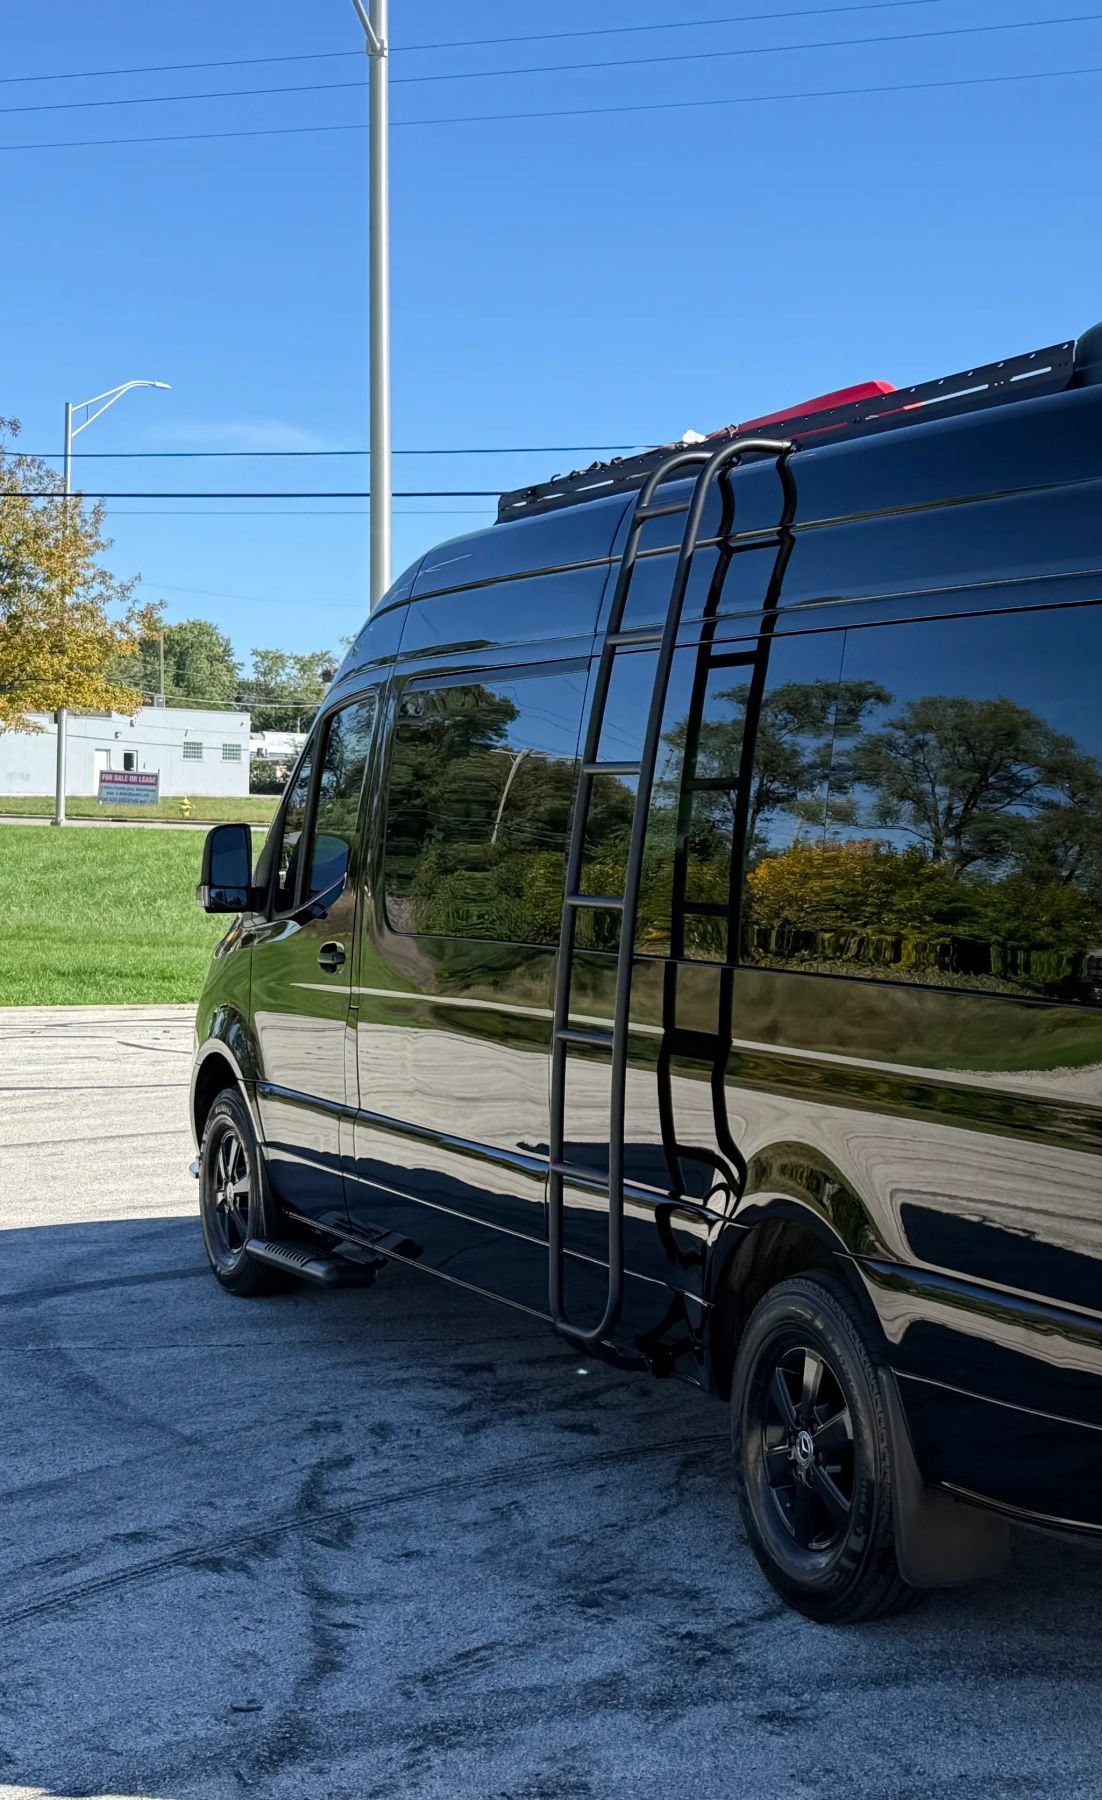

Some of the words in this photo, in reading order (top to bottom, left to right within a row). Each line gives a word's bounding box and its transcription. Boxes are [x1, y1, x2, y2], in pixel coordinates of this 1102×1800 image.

[101, 773, 113, 781] FOR
[114, 774, 128, 782] SALE
[129, 775, 138, 783] OR
[138, 775, 157, 784] LEASE
